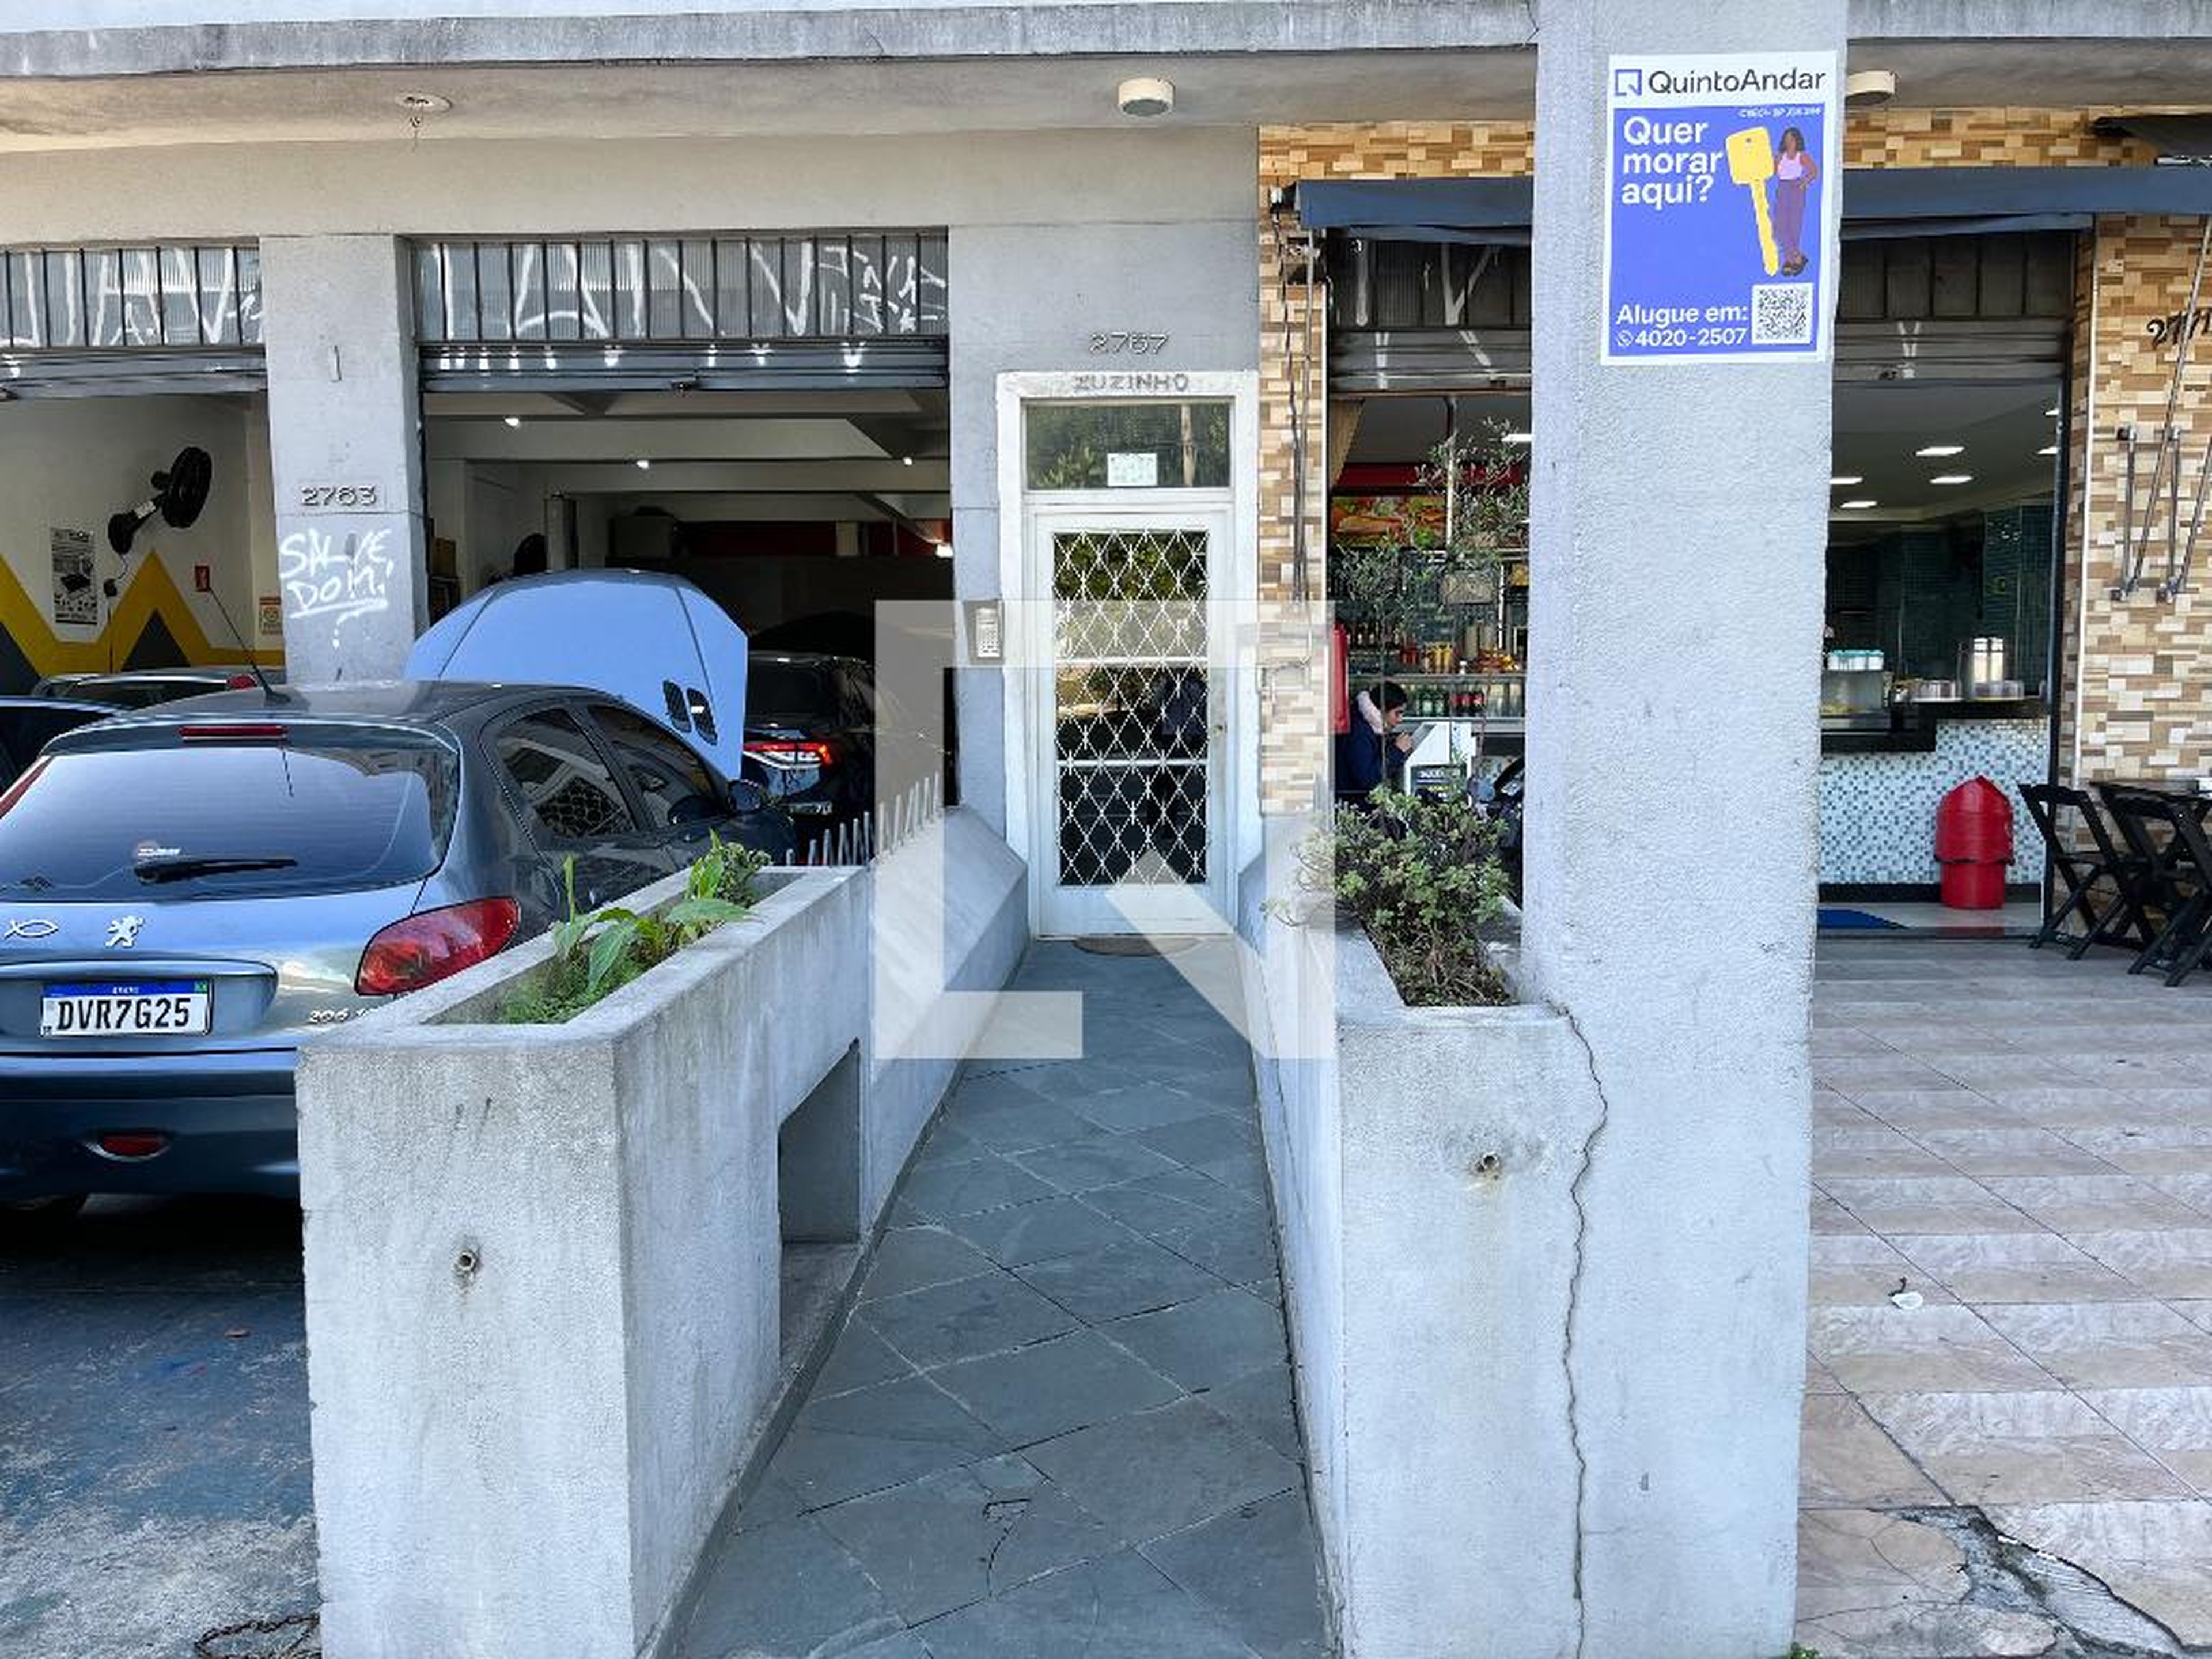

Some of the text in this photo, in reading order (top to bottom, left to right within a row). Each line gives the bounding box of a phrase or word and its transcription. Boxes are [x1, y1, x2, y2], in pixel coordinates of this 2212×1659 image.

[1649, 69, 1825, 94] QuintoAndar
[1623, 116, 1707, 145] Quer
[1622, 150, 1724, 173] morar
[1621, 175, 1714, 210] aqui?
[1615, 304, 1748, 328] Alugue em:
[1090, 332, 1169, 355] 2767
[1635, 327, 1747, 346] 4020-2507
[58, 998, 191, 1030] DVR7G25
